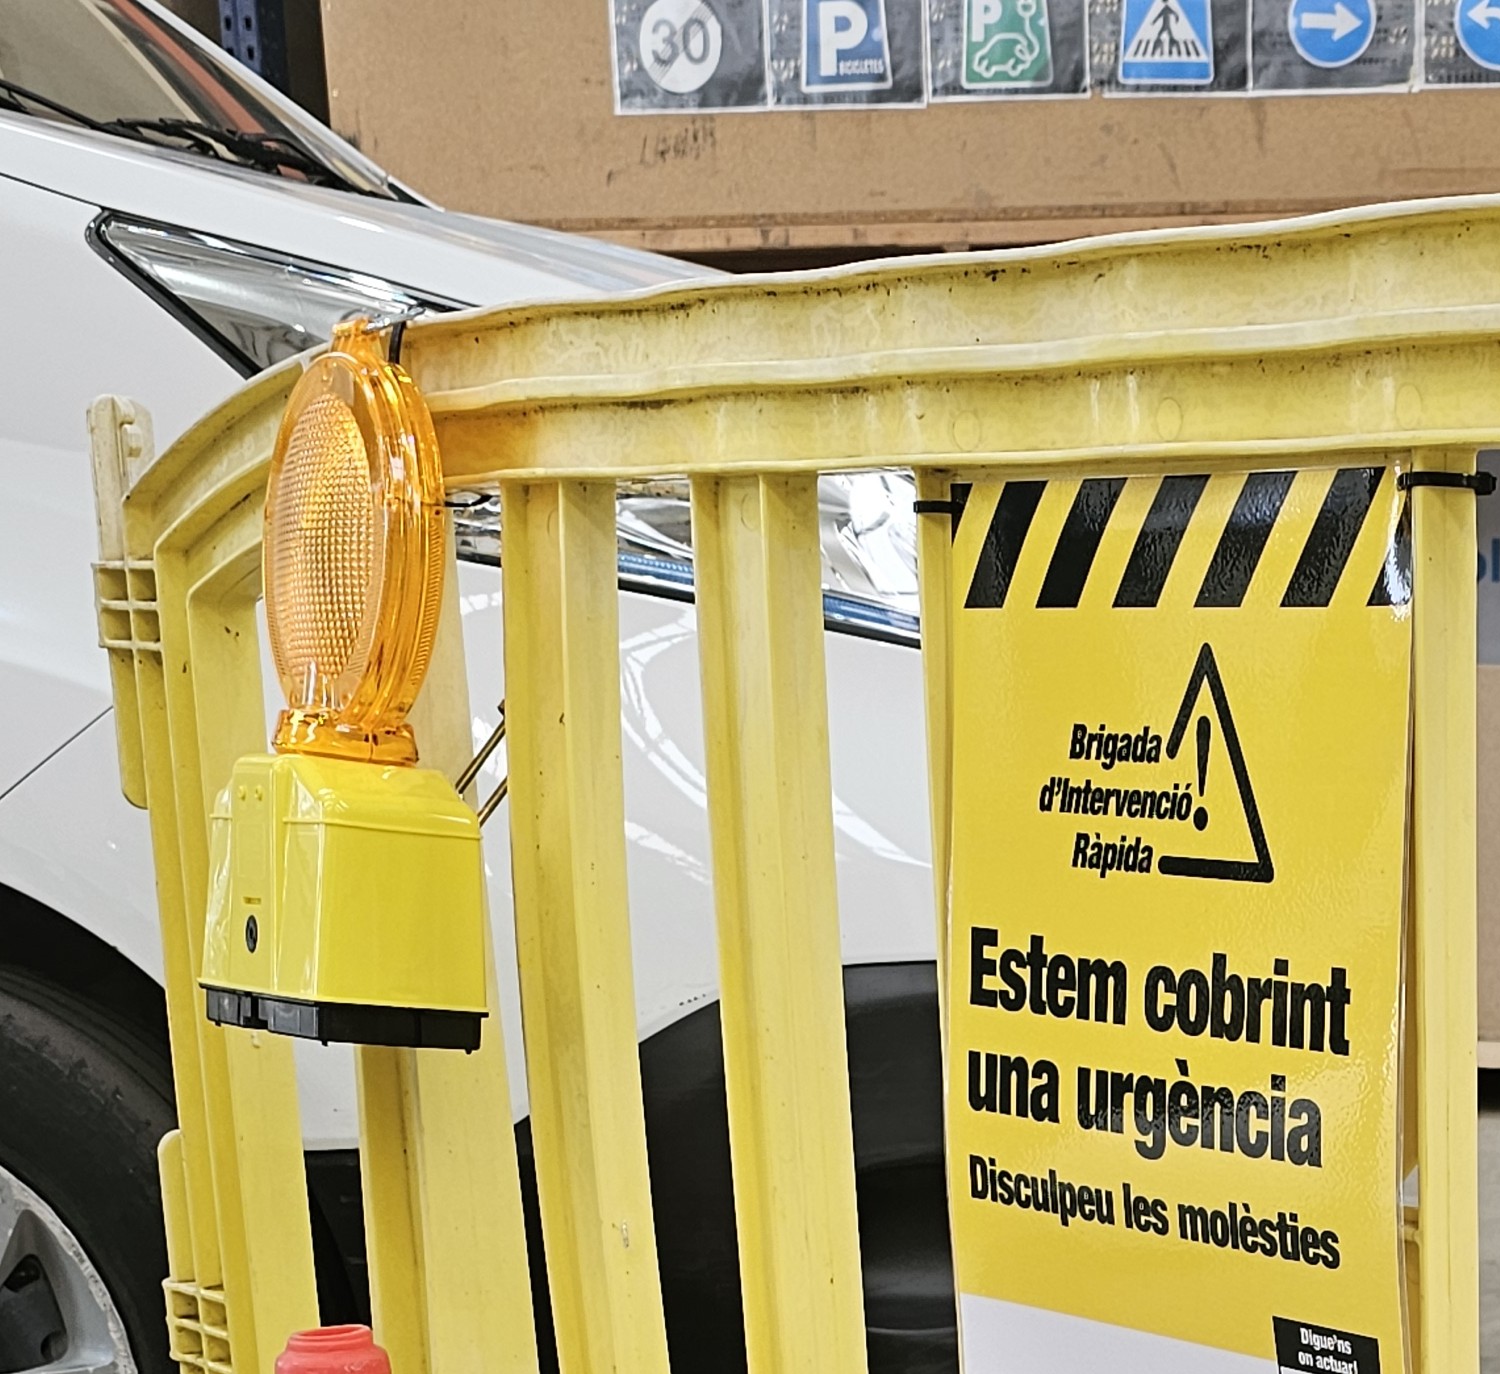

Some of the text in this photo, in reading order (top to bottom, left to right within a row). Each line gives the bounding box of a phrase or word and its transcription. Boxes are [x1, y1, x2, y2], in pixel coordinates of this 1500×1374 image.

[652, 18, 710, 65] 30
[820, 0, 867, 76] P
[1069, 723, 1162, 770] Brigada
[1039, 777, 1192, 822] d'Intervenció
[1072, 833, 1153, 878] Ràpida
[970, 926, 1351, 1056] Estem cobrint
[968, 1050, 1323, 1168] una urgència
[969, 1154, 1340, 1269] Disculpeu les molèsties
[1298, 1351, 1313, 1367] on
